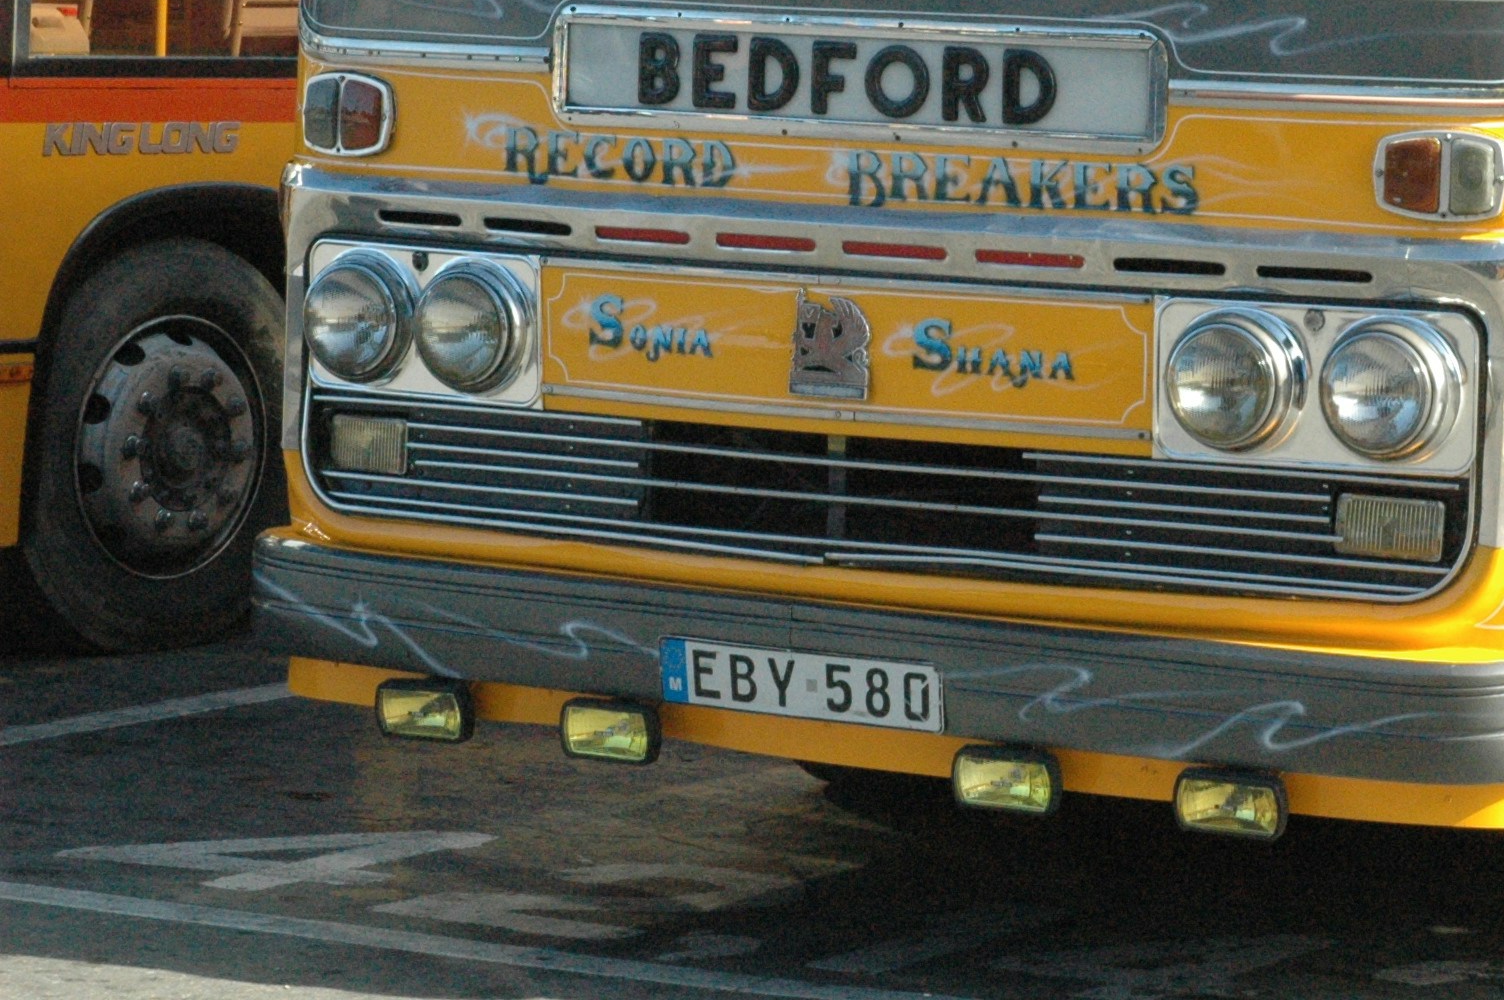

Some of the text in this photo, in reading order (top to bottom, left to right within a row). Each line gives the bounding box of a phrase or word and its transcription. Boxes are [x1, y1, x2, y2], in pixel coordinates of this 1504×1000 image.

[637, 31, 1058, 125] BEDFORD
[42, 121, 241, 157] KING LONG
[504, 126, 1199, 216] RECORD BREAKERS
[692, 649, 796, 708] EBY
[825, 662, 932, 723] 580
